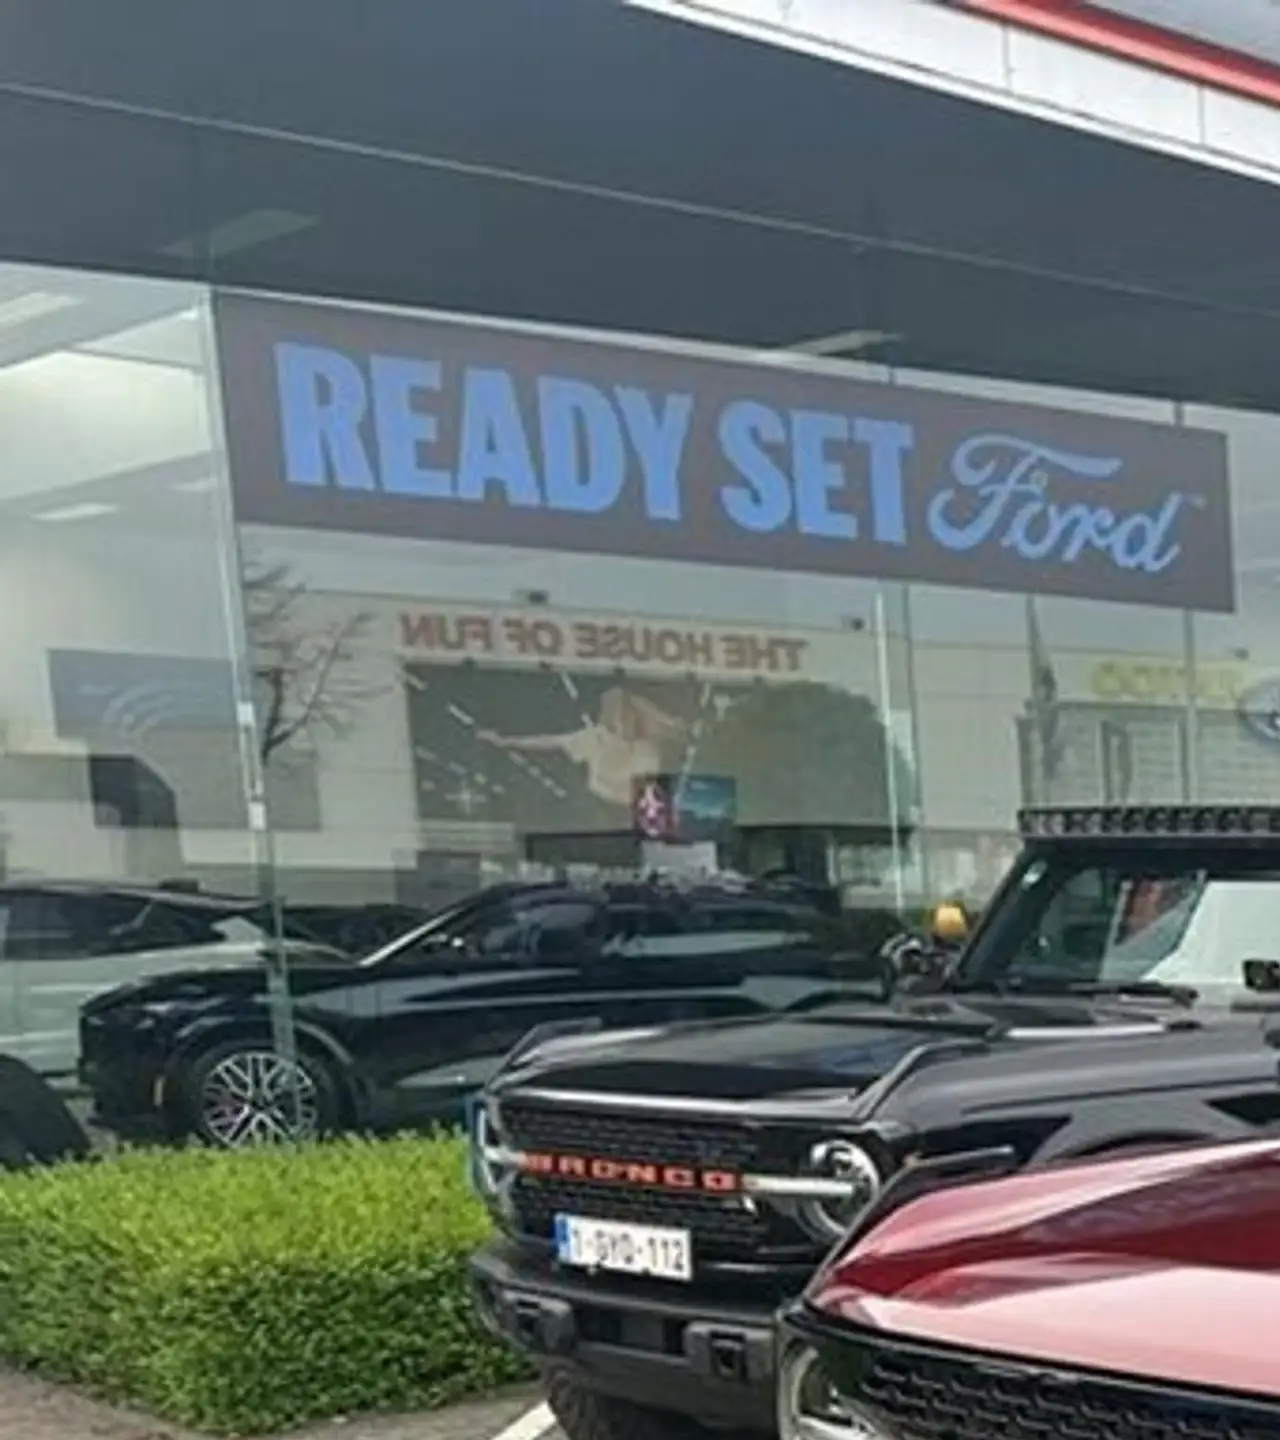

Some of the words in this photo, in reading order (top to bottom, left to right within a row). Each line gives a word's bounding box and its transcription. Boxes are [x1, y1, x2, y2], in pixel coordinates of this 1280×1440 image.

[273, 342, 694, 521] READY
[718, 399, 914, 545] SET
[927, 432, 1184, 573] Ford
[526, 1153, 737, 1191] BRONCO
